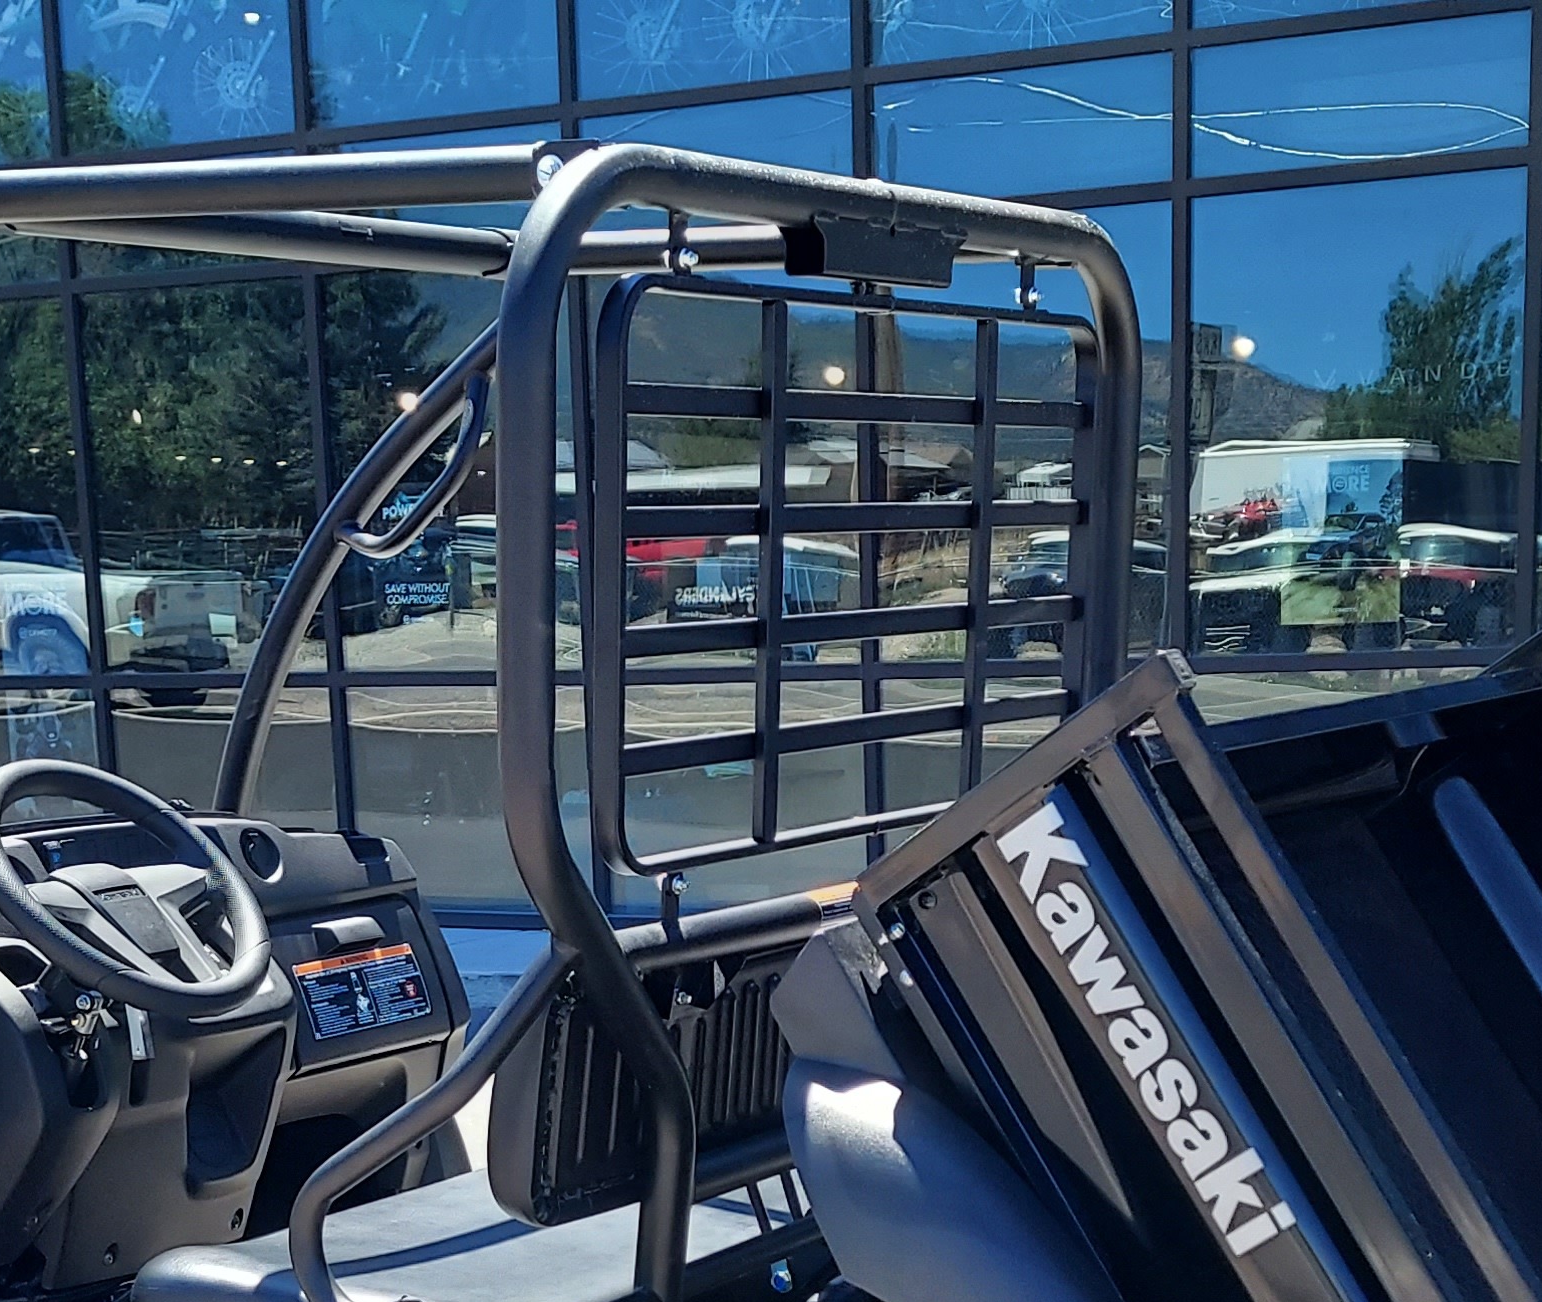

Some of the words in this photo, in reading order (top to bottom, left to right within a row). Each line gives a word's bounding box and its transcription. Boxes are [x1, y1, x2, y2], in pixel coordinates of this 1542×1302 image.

[384, 583, 407, 594] SAVE
[408, 582, 450, 594] WITHOUT
[995, 801, 1297, 1258] Kawasaki
